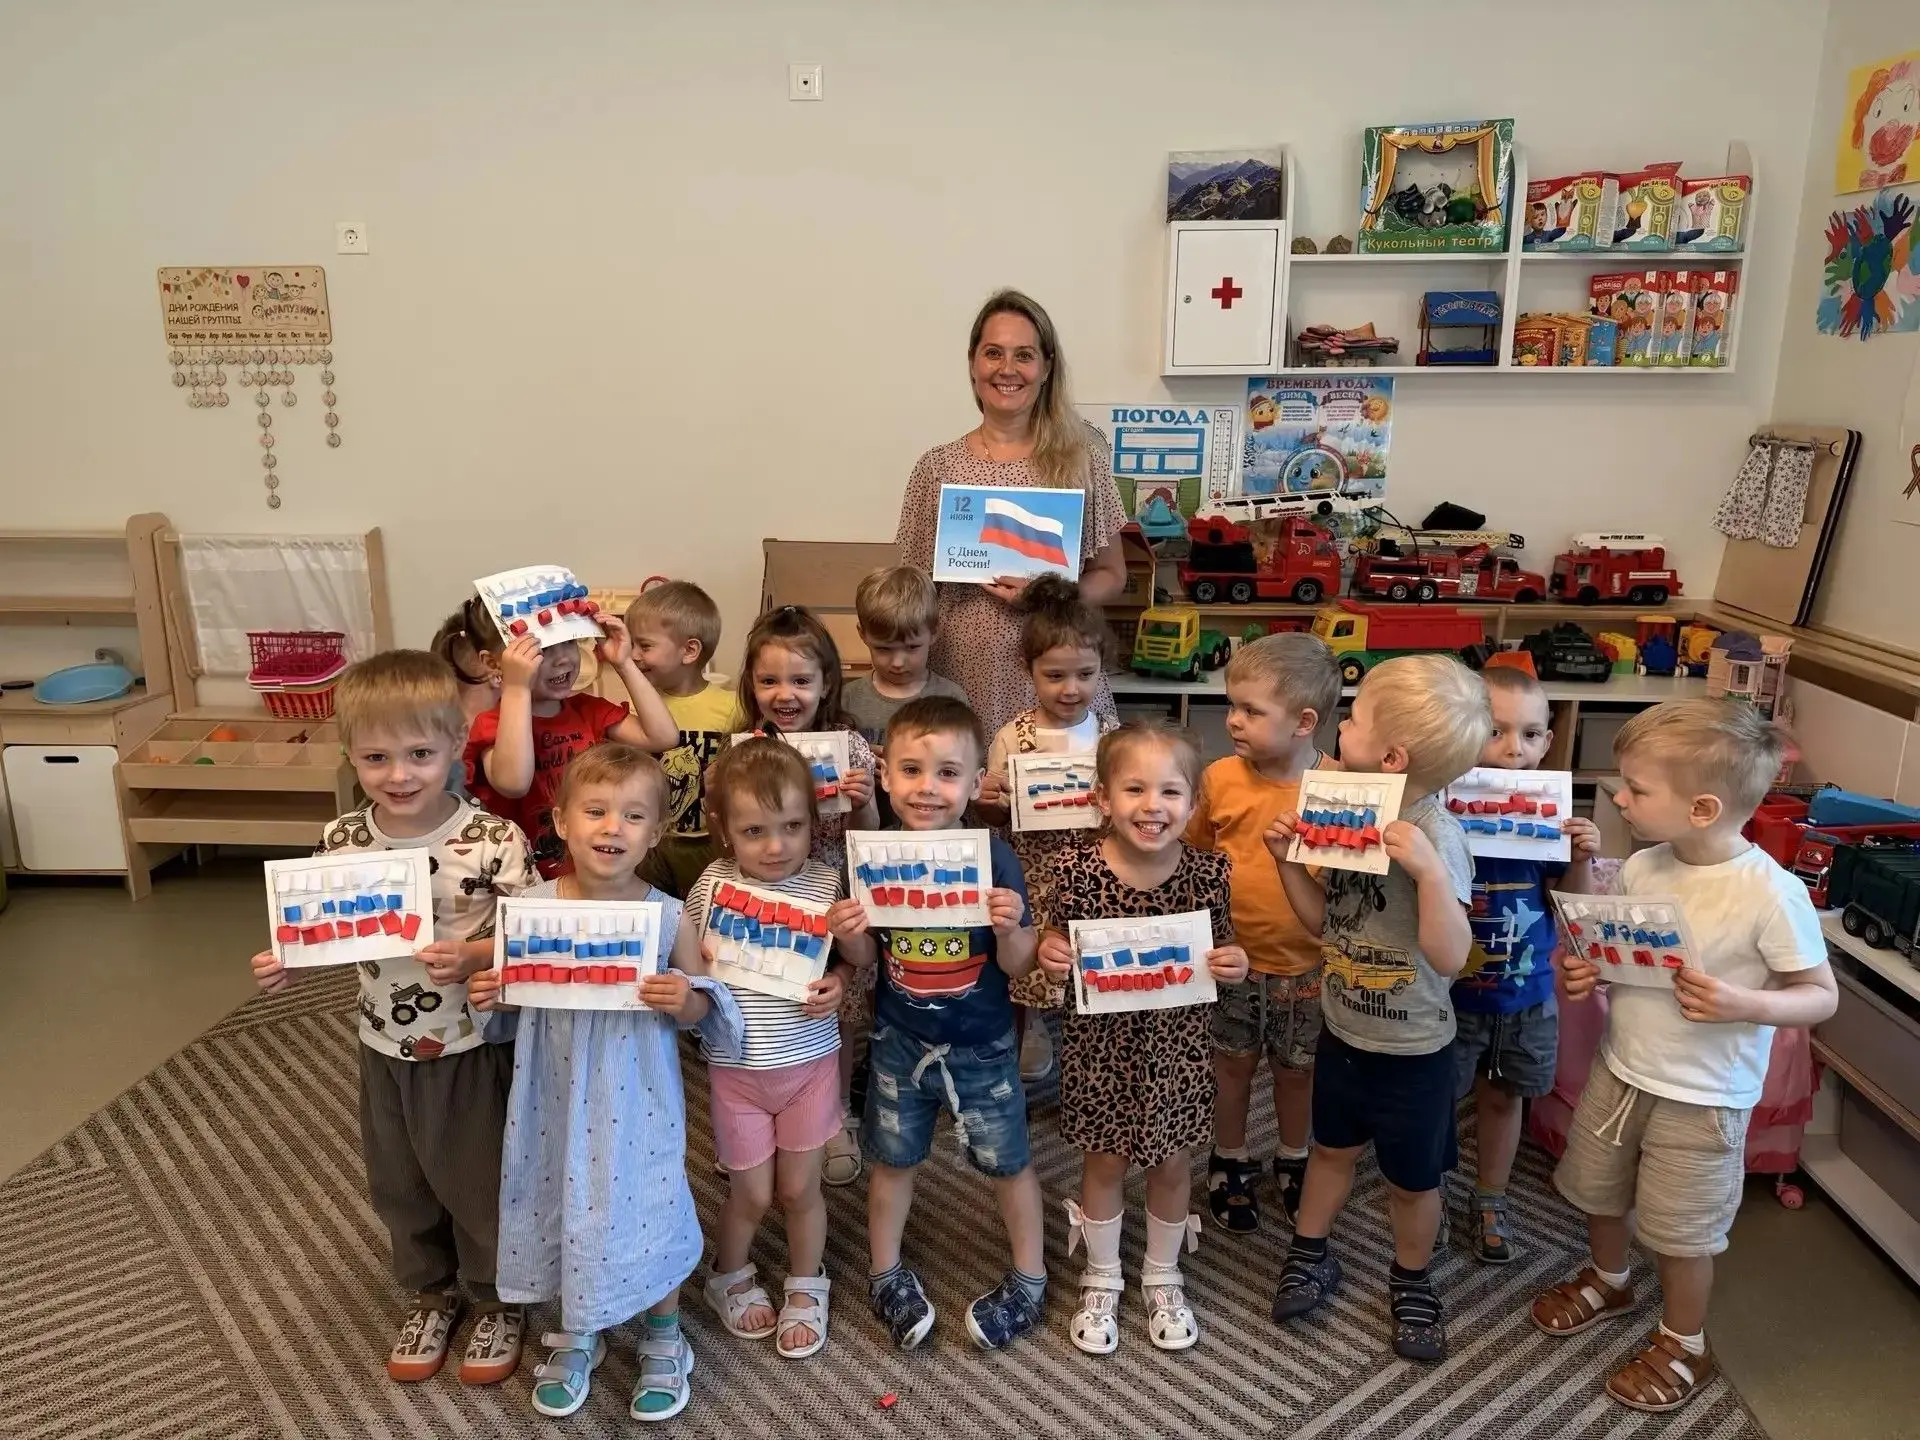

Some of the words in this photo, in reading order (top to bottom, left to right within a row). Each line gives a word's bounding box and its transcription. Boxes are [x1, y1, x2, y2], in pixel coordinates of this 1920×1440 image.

[1367, 237, 1446, 251] Кукольный
[1451, 236, 1493, 249] театр
[168, 303, 188, 312] ДНИ
[189, 303, 239, 312] РОЖДЕНИЯ
[264, 304, 318, 318] КАРАПУЗИКИ
[168, 314, 200, 324] НАШЕЙ
[202, 316, 242, 324] ГРУППЫ
[1266, 379, 1332, 389] ВРЕМЕНА
[1336, 379, 1375, 389] ГОДА
[1281, 392, 1308, 400] ЗИМА
[1329, 392, 1361, 400] ВЕСНА
[1112, 409, 1210, 425] ПОГОДА
[954, 496, 971, 512] 12
[947, 546, 956, 556] С
[957, 547, 988, 558] Днем
[948, 557, 990, 569] России!
[1360, 989, 1387, 1006] Old
